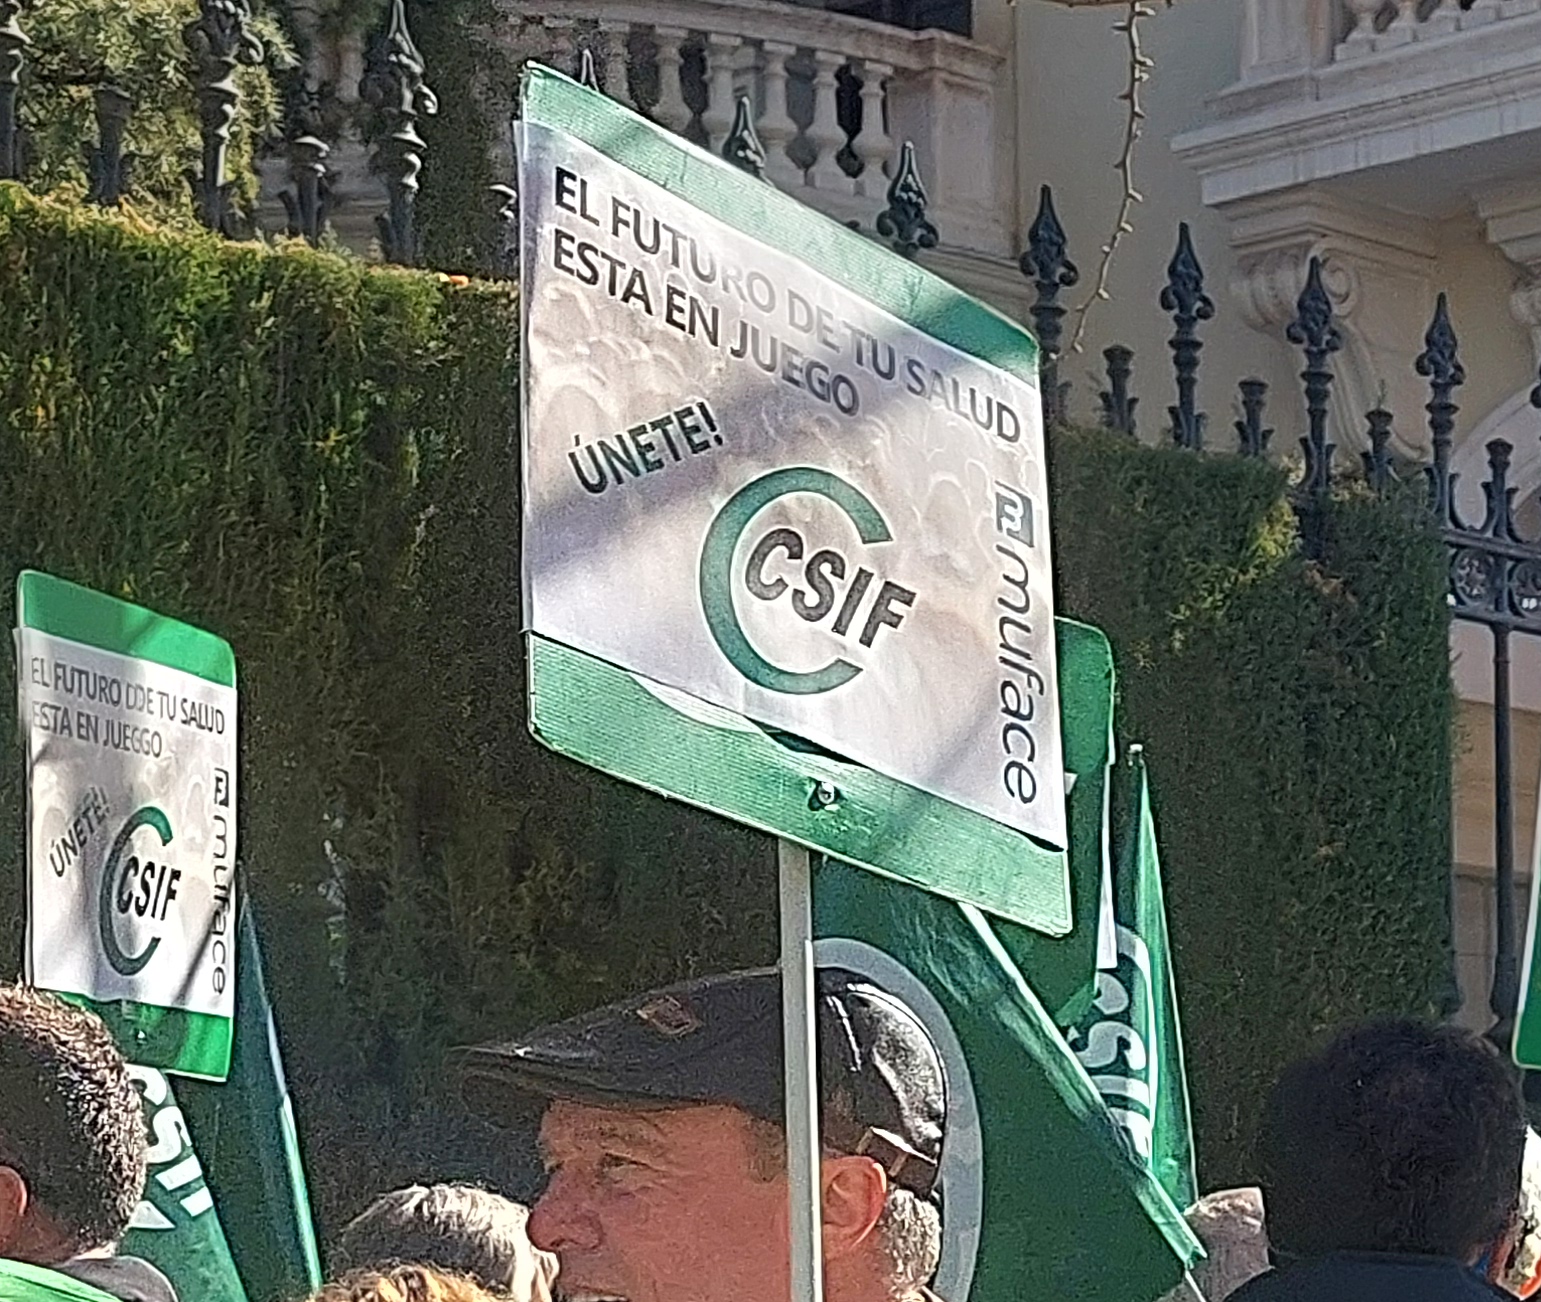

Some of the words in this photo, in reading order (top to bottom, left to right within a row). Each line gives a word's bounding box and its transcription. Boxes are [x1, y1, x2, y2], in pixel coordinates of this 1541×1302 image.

[552, 228, 653, 315] ESTA
[665, 282, 720, 347] EN
[730, 320, 860, 417] JUEGO
[553, 166, 599, 227] EL
[612, 195, 775, 314] FUTURO
[787, 288, 841, 353] DE
[838, 321, 897, 381] TU
[906, 358, 1020, 444] SALUD
[568, 401, 725, 494] ÚNETE!
[745, 529, 916, 648] CSIF
[31, 657, 50, 687] EL
[54, 661, 121, 707] FUTURO
[157, 691, 177, 721] TU
[180, 698, 225, 735] SALUD
[32, 702, 73, 738] ESTA
[77, 711, 99, 744] EN
[996, 544, 1044, 805] muface
[117, 855, 181, 921] CSIF
